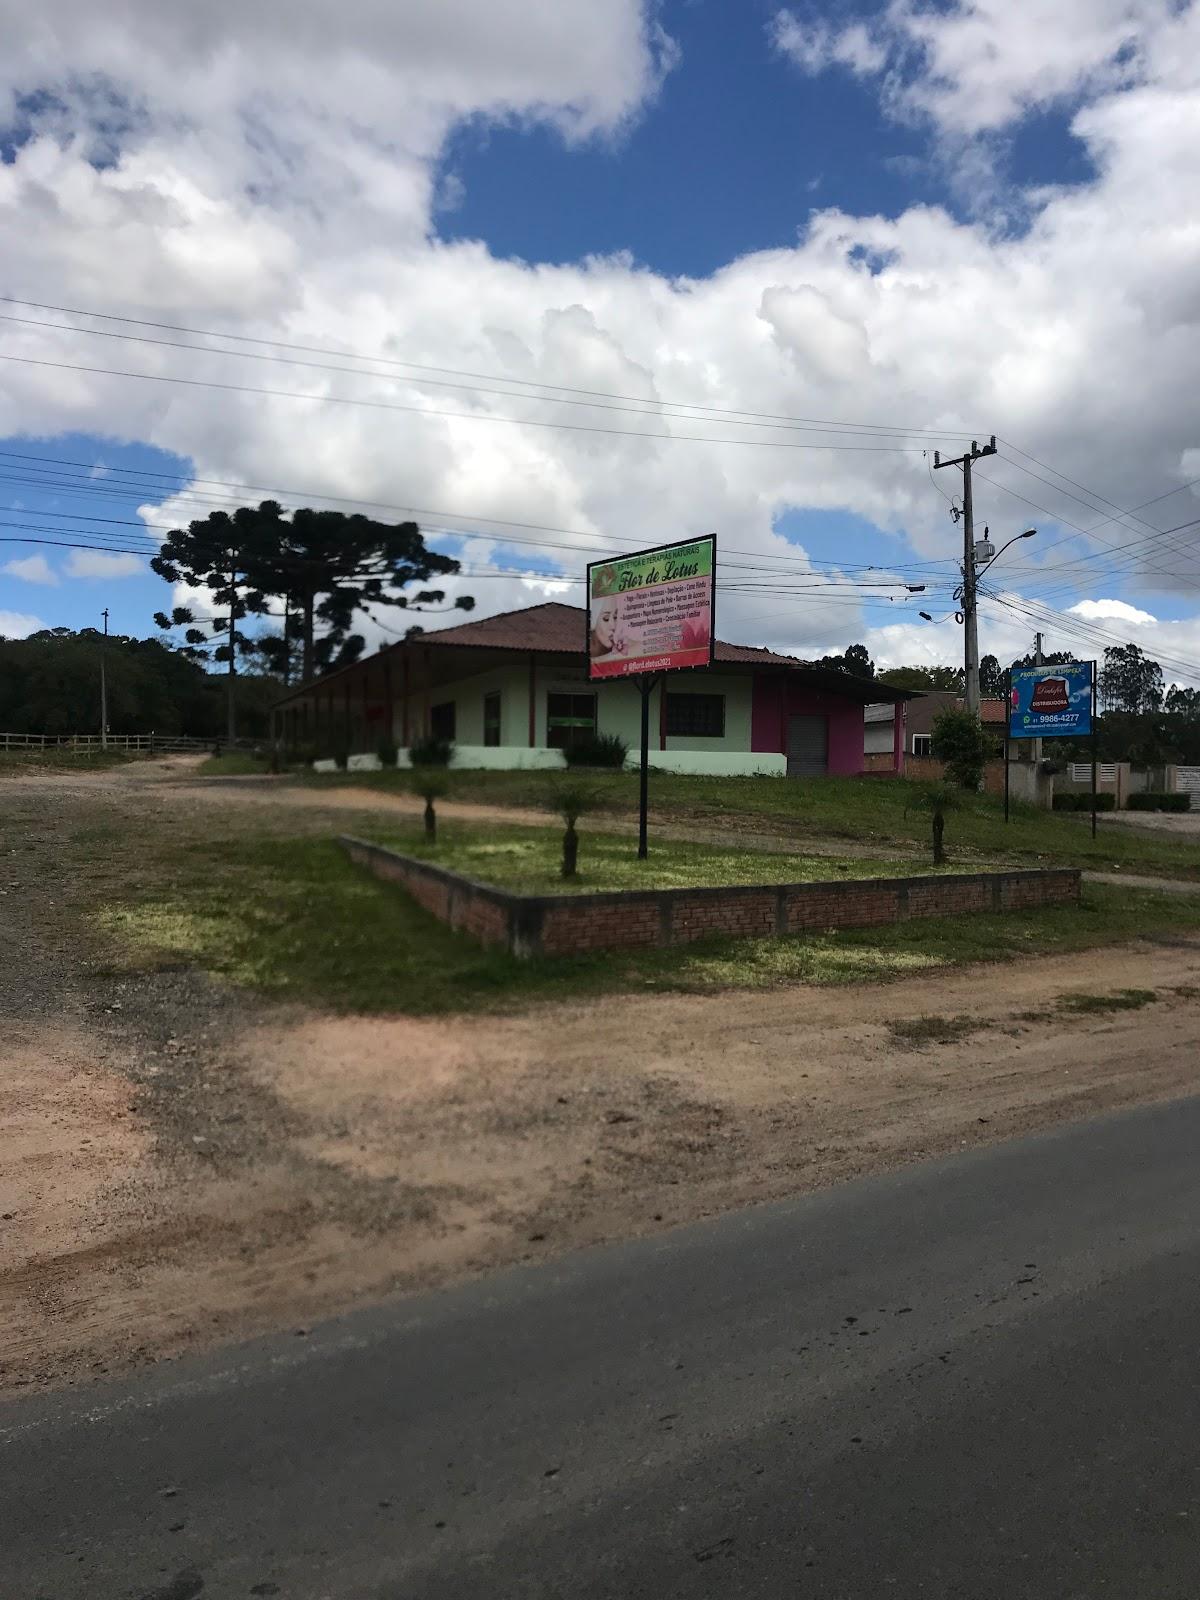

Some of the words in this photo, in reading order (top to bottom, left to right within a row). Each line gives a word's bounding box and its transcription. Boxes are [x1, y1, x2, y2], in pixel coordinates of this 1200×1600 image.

[646, 552, 672, 564] TERAPIAS
[673, 547, 700, 559] NATURAIS
[619, 570, 643, 592] Flor
[646, 567, 660, 584] de
[662, 561, 699, 581] Lotus
[1040, 713, 1080, 723] 9986-4277
